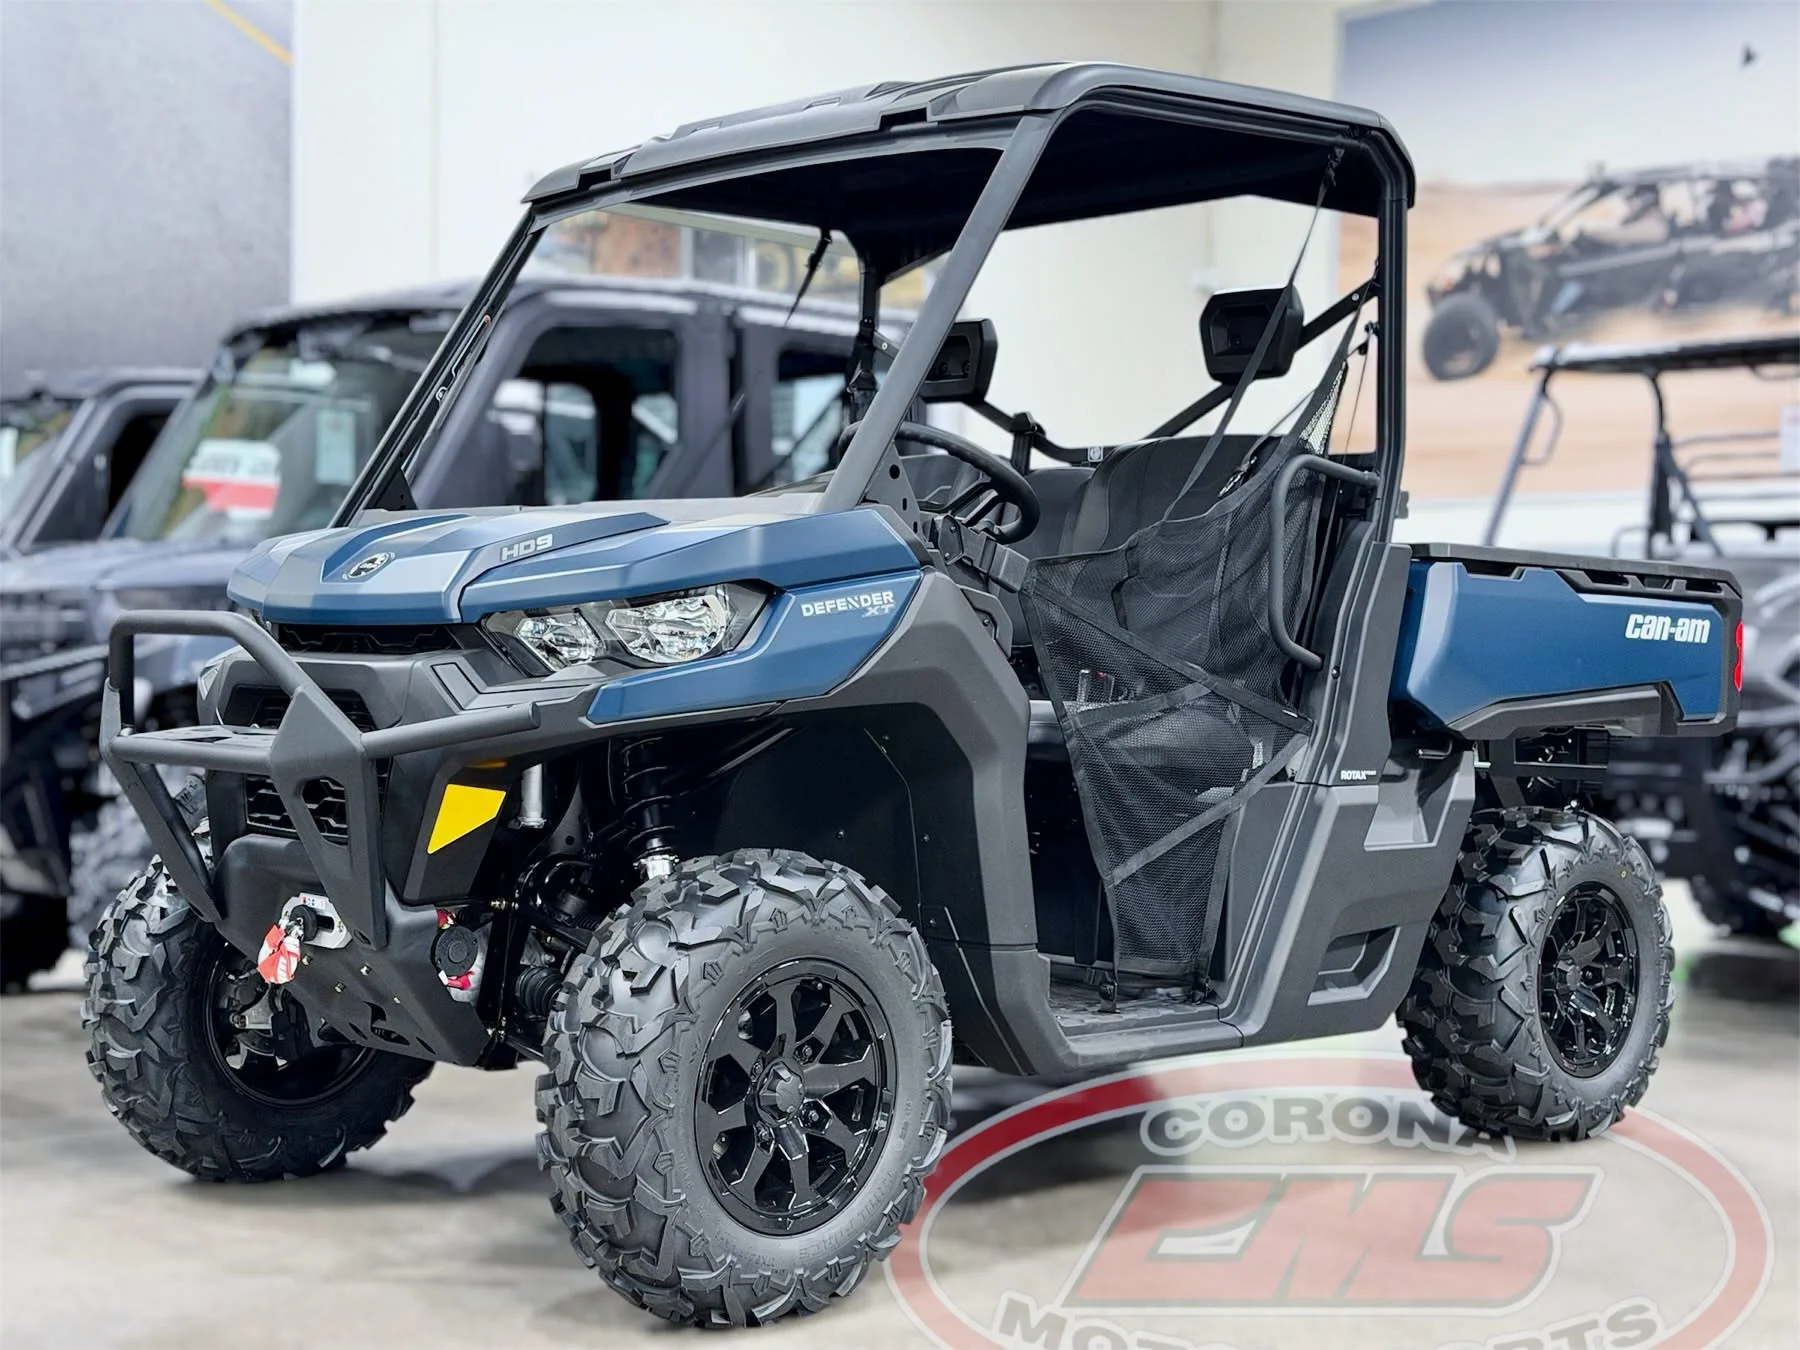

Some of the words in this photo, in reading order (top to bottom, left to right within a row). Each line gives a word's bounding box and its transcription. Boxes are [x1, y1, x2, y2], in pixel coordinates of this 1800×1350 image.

[501, 533, 553, 561] HD9
[801, 591, 894, 617] DEFENDER
[862, 604, 894, 618] XT
[1625, 613, 1711, 644] can-am
[1340, 770, 1367, 780] ROTAX
